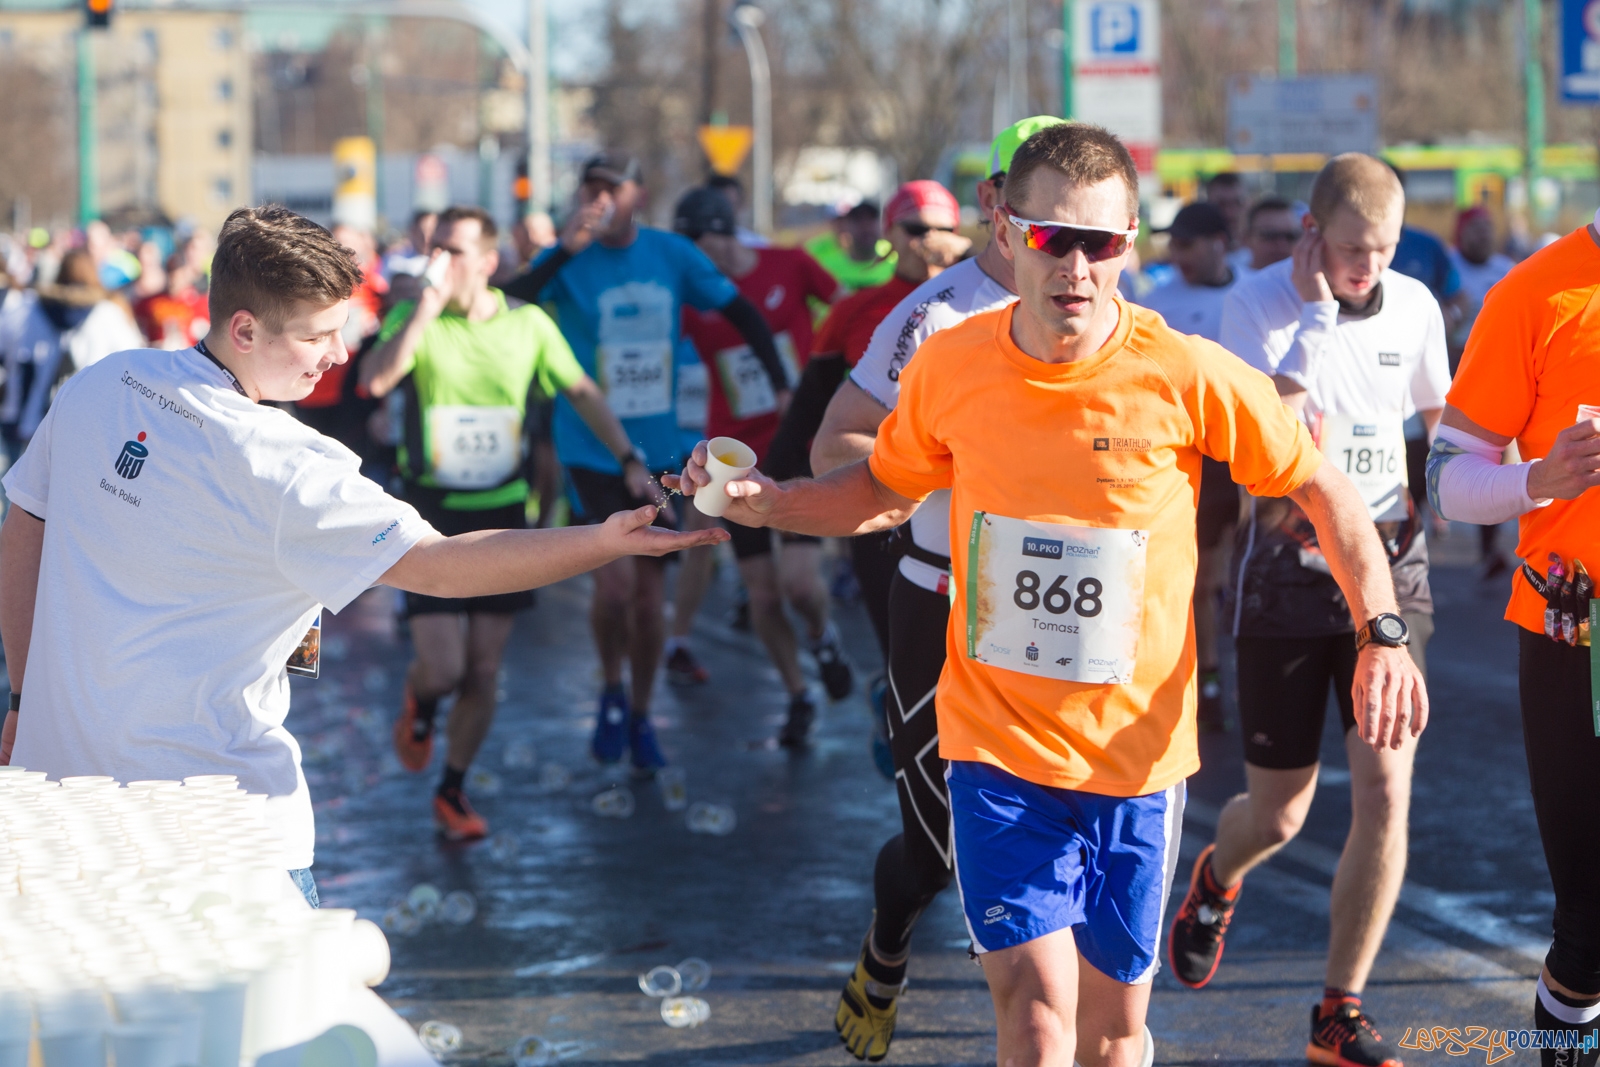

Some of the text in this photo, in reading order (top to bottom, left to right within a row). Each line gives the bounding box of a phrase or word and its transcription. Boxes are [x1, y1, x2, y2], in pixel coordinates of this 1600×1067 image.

[121, 370, 204, 428] Sponsor tytularny
[1112, 438, 1152, 448] TRIATHLON
[1343, 448, 1397, 474] 1816
[100, 478, 142, 507] Bank Polski
[1026, 542, 1038, 552] 10.
[1040, 545, 1060, 554] PKO
[1013, 569, 1103, 618] 868
[1032, 617, 1080, 634] Tomasz
[1055, 657, 1073, 666] 4F
